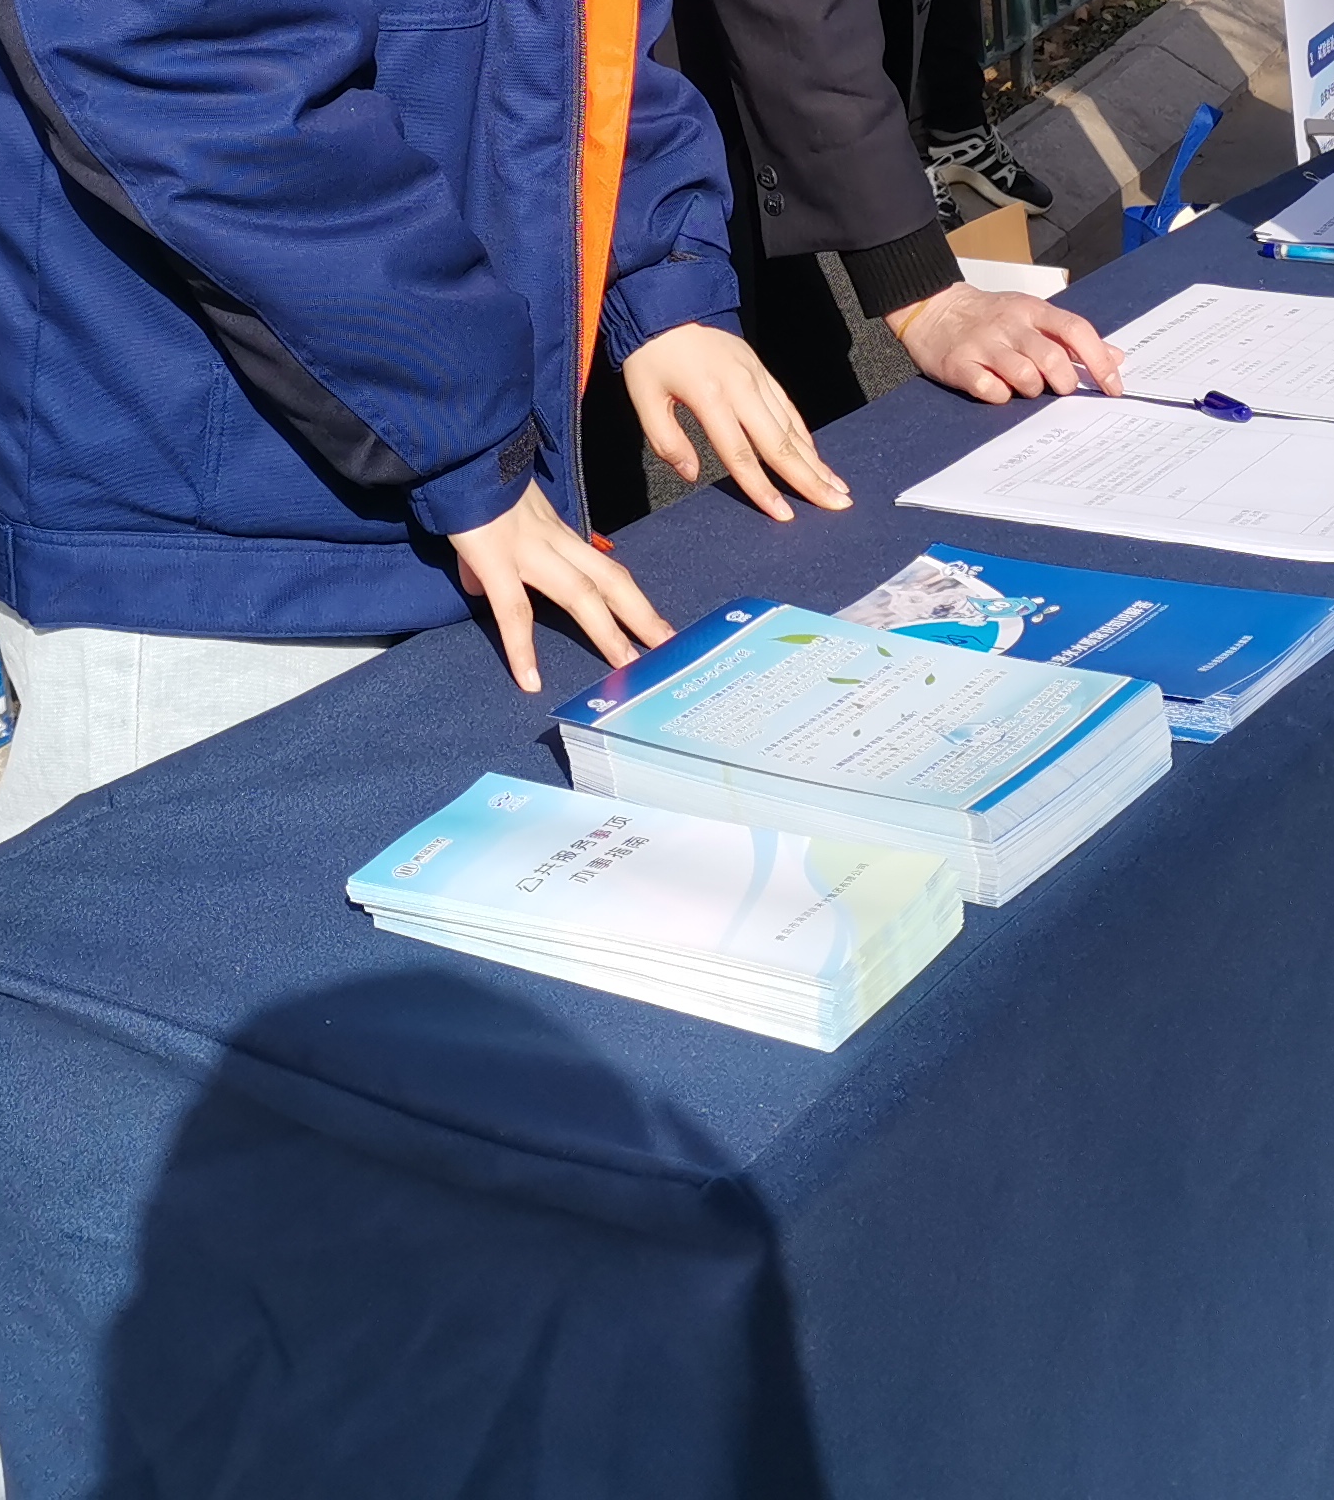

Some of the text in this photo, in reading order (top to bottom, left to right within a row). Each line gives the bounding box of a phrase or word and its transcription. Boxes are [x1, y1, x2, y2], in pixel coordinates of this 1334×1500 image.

[515, 815, 633, 893] 公共服务事项
[568, 835, 650, 884] 办事指南
